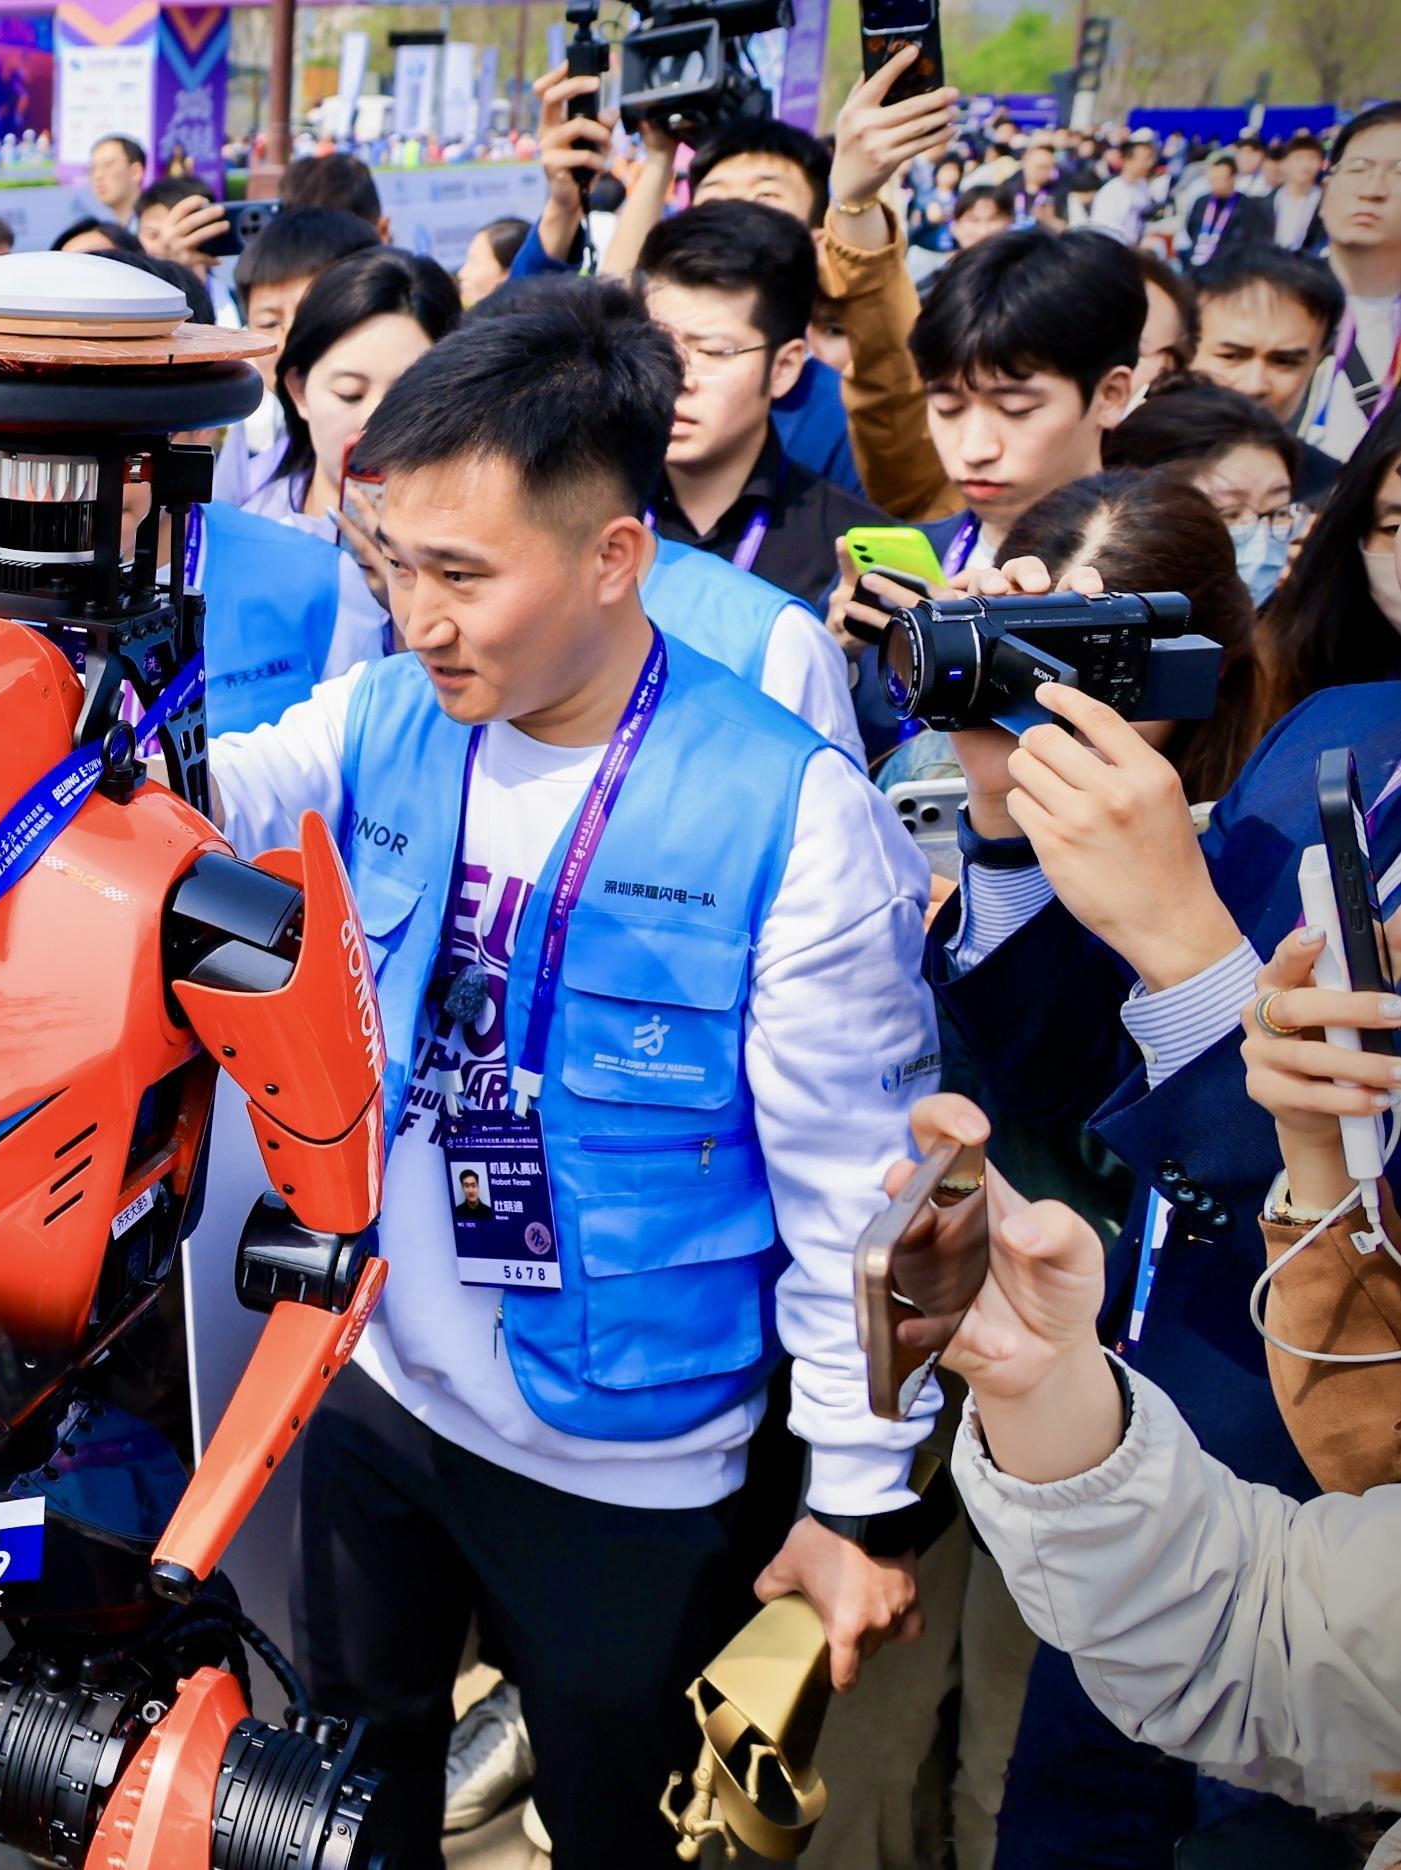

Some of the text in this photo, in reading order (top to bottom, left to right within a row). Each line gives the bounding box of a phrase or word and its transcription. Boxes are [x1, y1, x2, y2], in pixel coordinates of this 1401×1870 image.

[1033, 667, 1054, 683] SONY
[52, 772, 80, 801] BEIJING
[59, 794, 75, 808] AND
[603, 880, 716, 907] 深圳荣耀闪电一队
[341, 919, 381, 1068] HONOR
[491, 1178, 511, 1186] Robot
